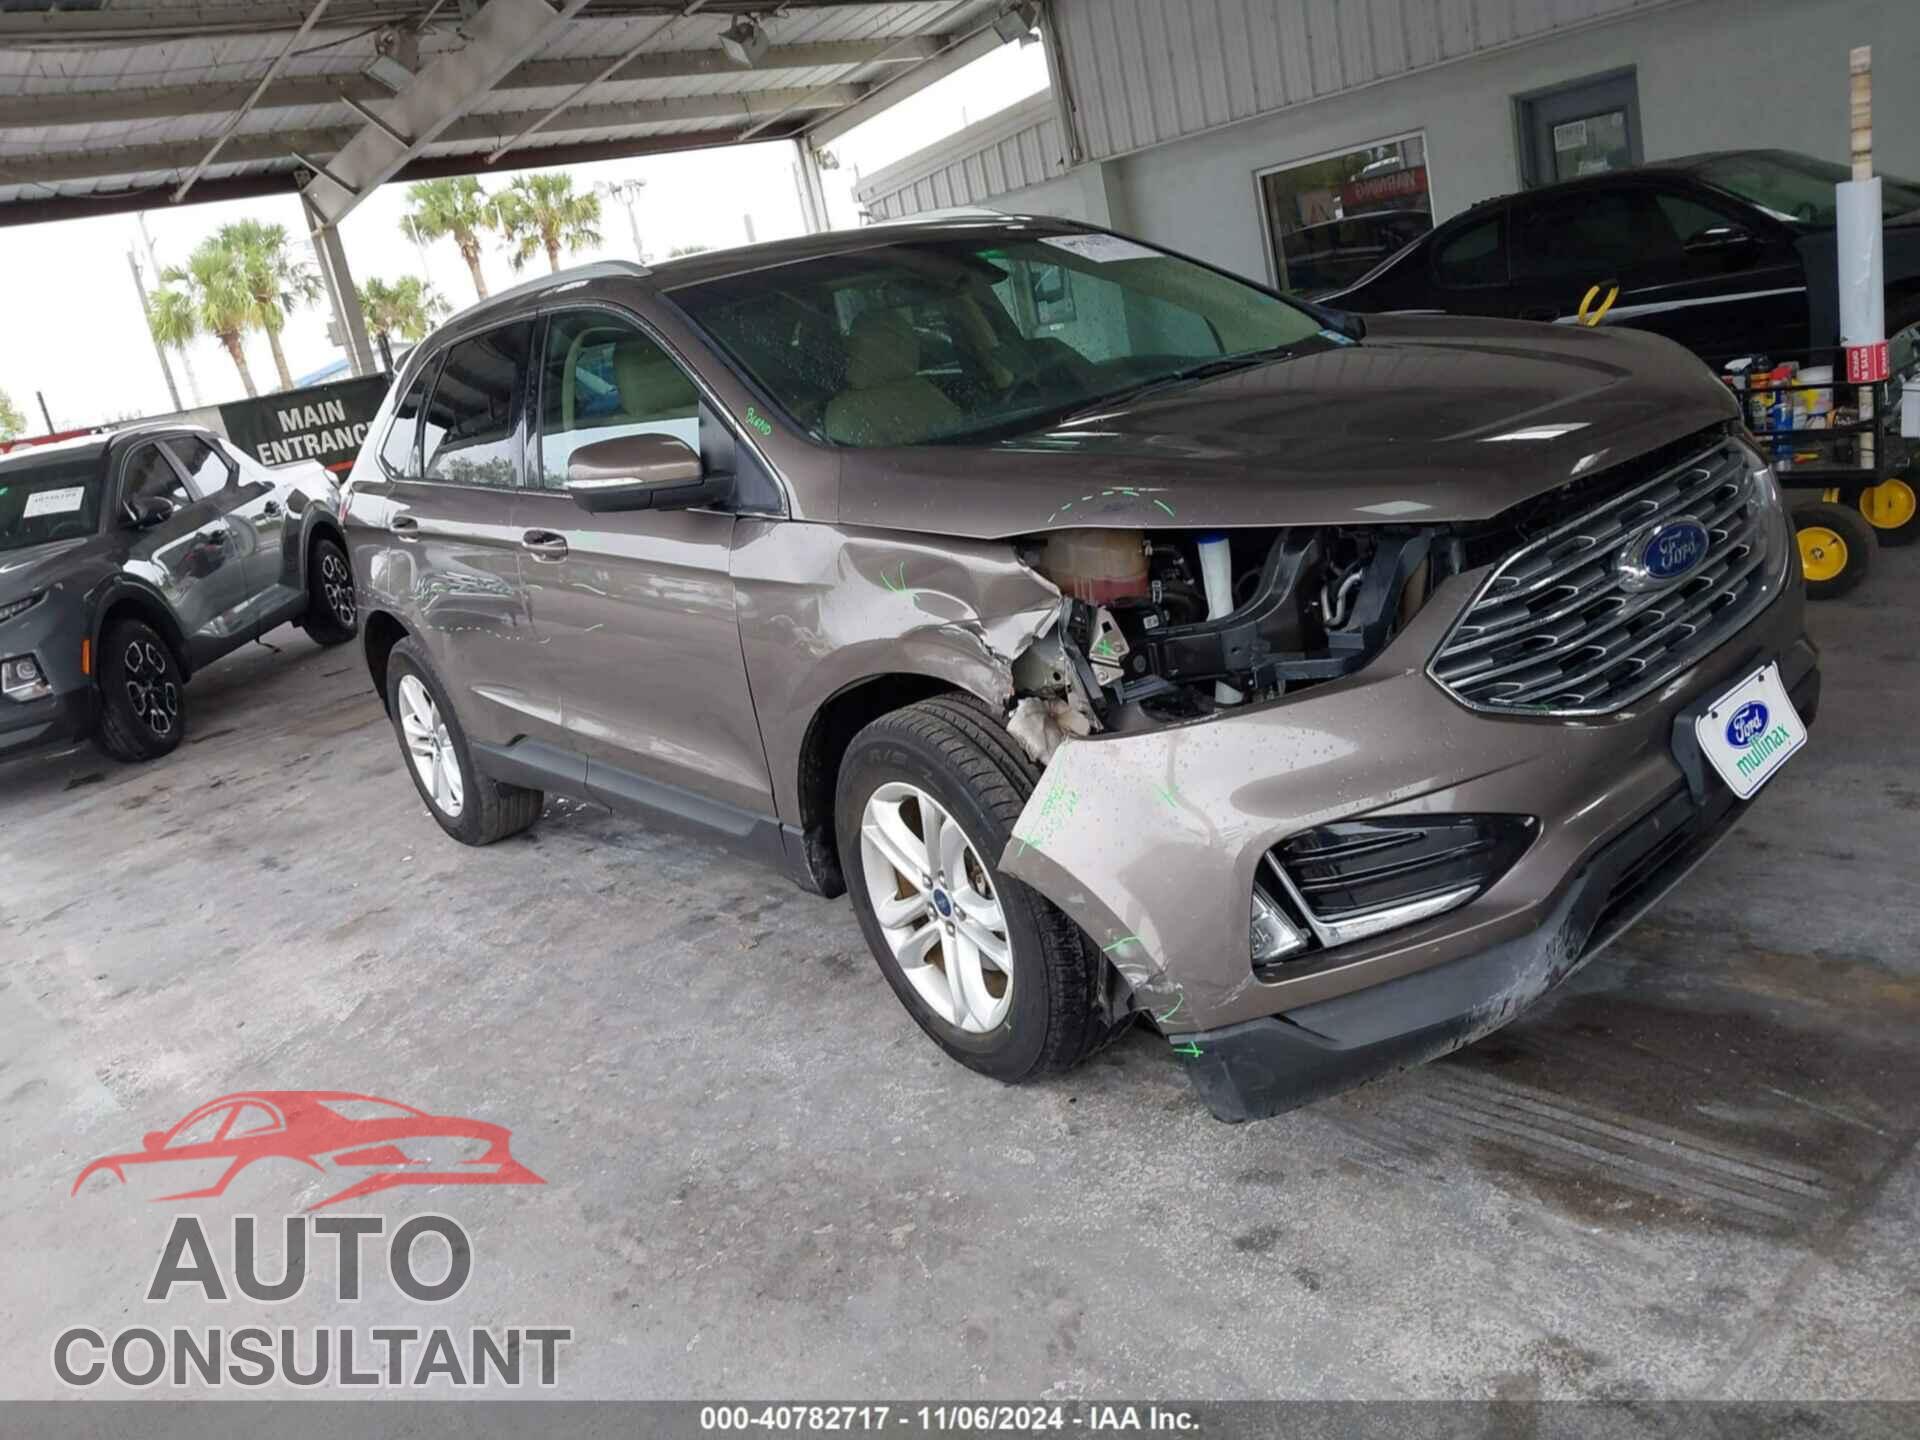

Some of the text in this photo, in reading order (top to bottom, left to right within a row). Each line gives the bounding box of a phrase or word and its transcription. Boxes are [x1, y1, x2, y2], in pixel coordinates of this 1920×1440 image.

[277, 399, 346, 432] MAIN
[257, 421, 372, 466] ENTRANC
[1659, 531, 1697, 569] Ford
[1732, 707, 1763, 743] Ford
[1736, 724, 1791, 778] mullinax
